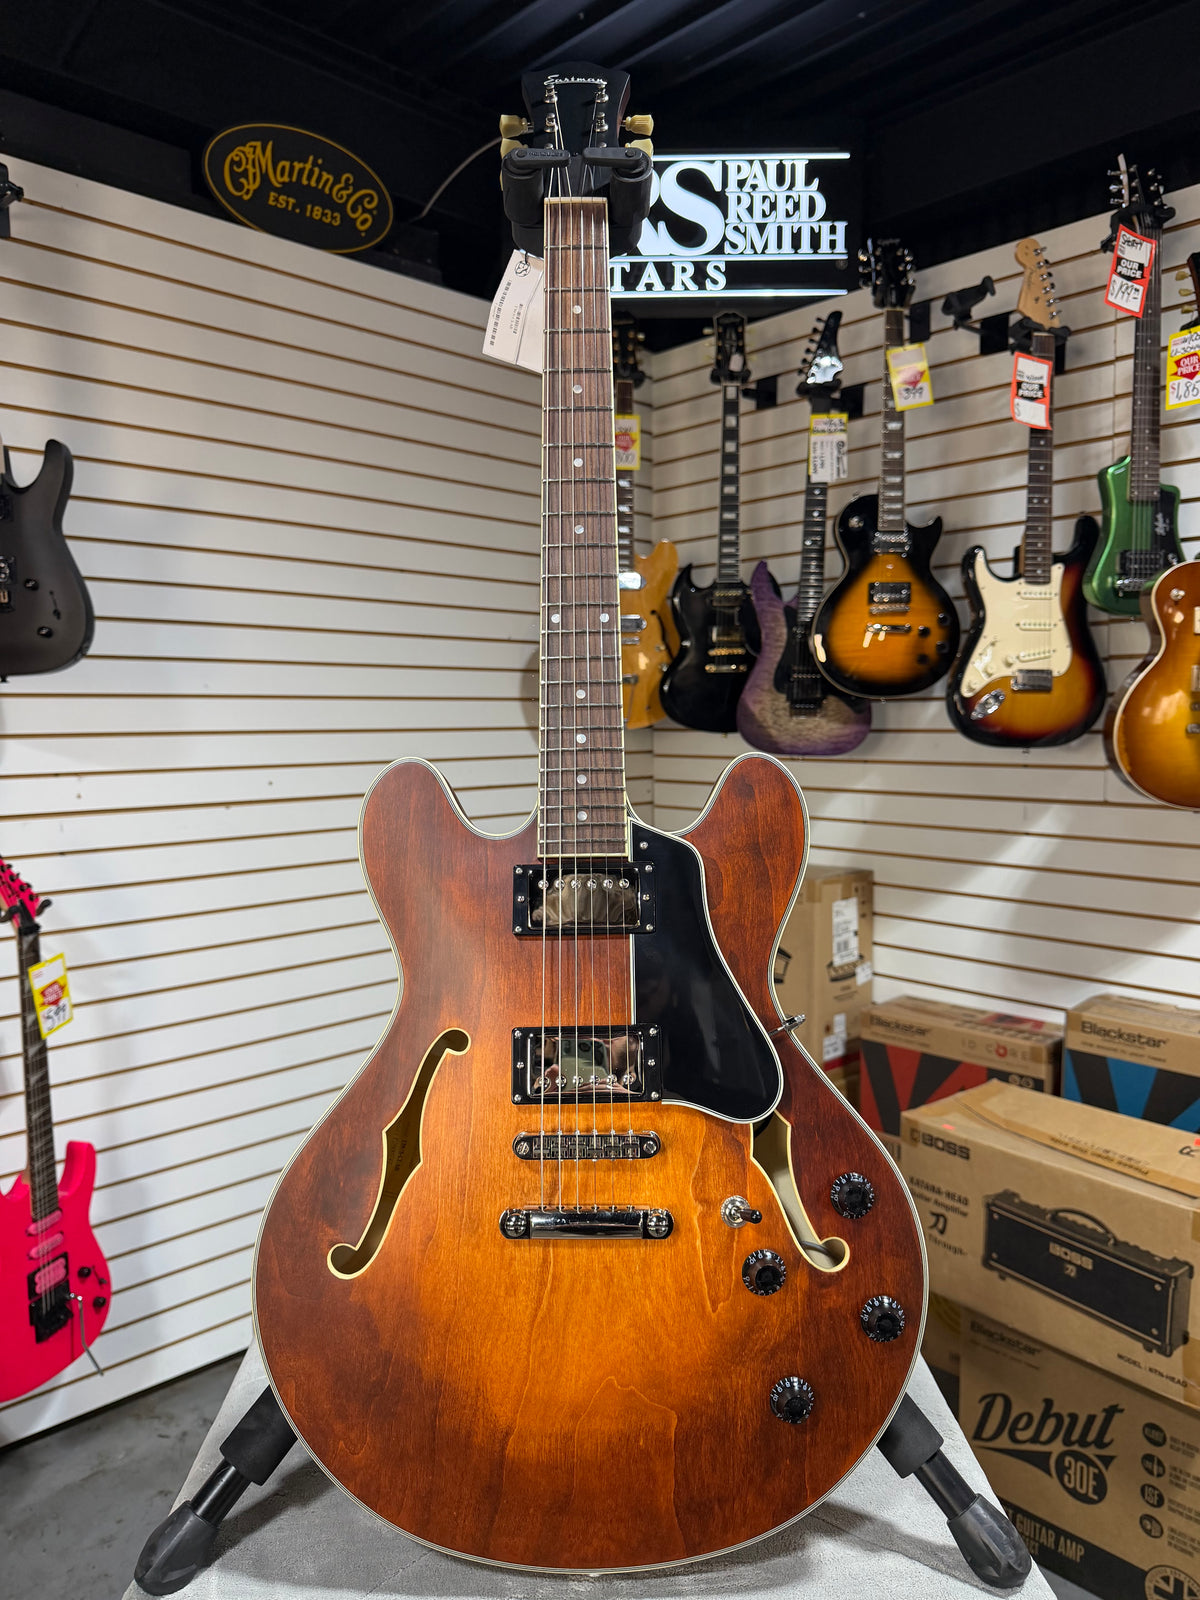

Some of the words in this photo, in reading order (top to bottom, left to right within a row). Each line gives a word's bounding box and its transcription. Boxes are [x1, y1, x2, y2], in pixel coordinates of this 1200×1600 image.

[544, 74, 608, 86] Eastman
[725, 160, 819, 192] PAUL
[268, 192, 300, 213] EST.
[305, 204, 341, 226] 1833
[725, 191, 827, 223] REED
[724, 221, 849, 255] SMITH
[610, 261, 727, 292] TARS
[1117, 266, 1143, 279] PRICE
[1120, 259, 1139, 270] OUR
[1180, 355, 1199, 368] OUR
[869, 1014, 930, 1037] Blackstar
[1081, 1020, 1167, 1048] Blackstar
[921, 1131, 971, 1160] BOSS
[972, 1392, 1125, 1449] Debut
[1062, 1454, 1100, 1500] 30E
[1016, 1513, 1056, 1550] GUITAR
[1058, 1536, 1085, 1563] AMP
